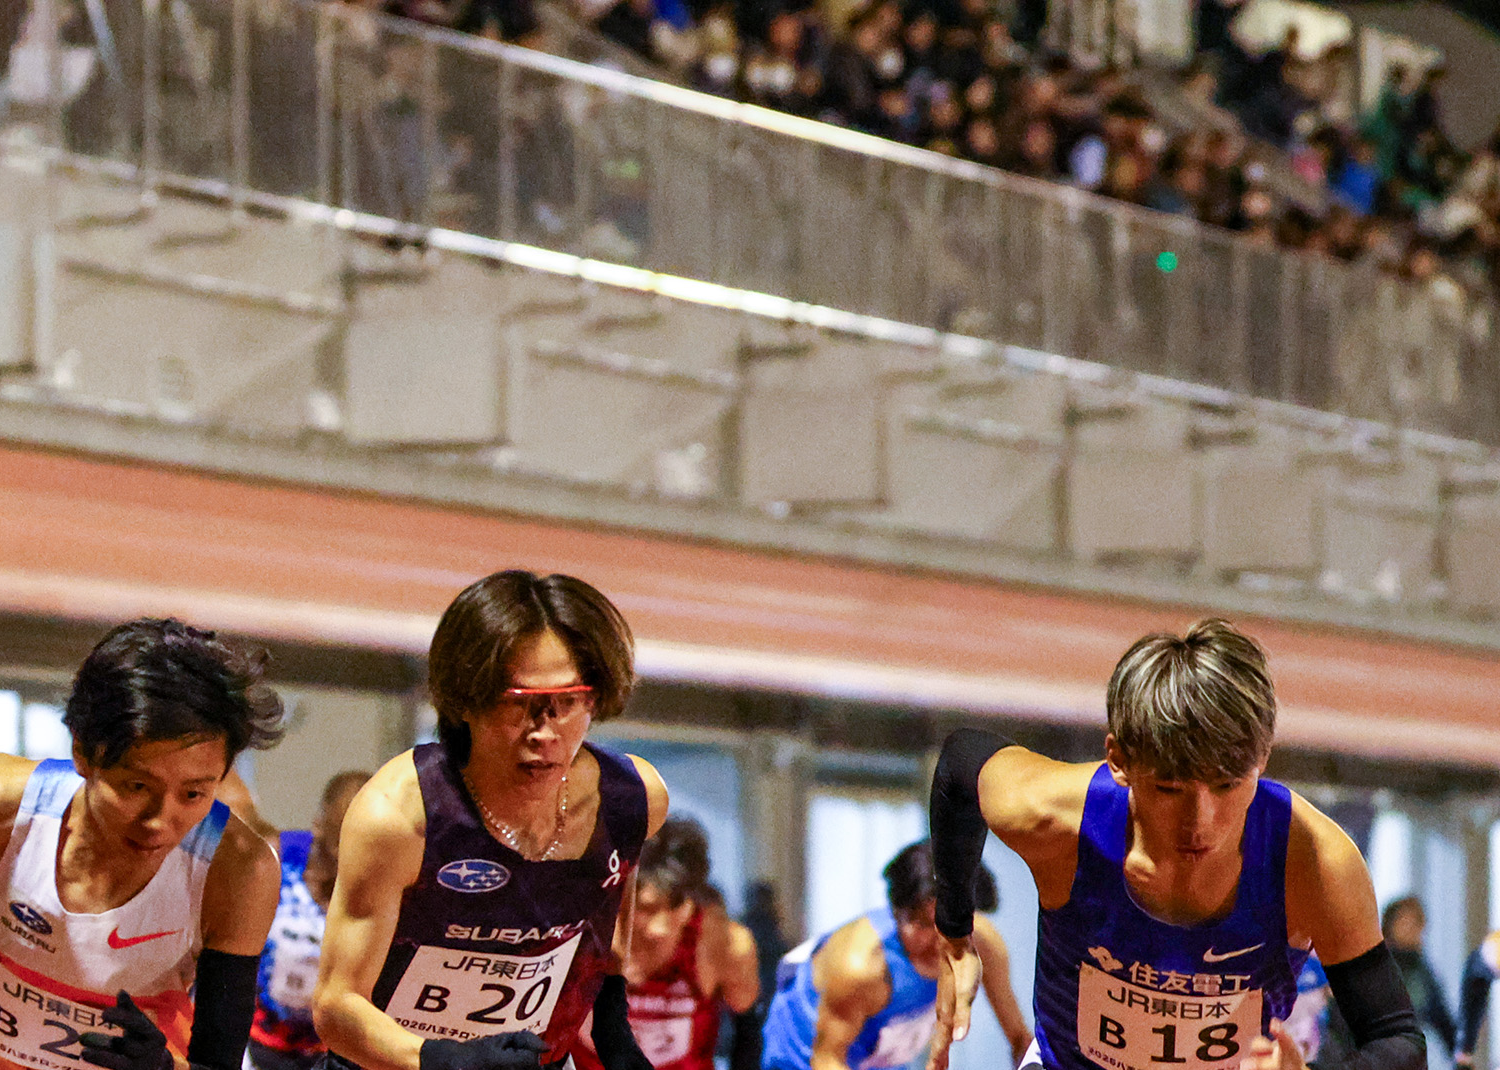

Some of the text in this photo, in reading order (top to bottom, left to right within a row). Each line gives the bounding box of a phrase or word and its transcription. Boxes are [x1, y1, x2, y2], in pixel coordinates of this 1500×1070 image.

[1, 915, 56, 954] SUBARU
[444, 953, 559, 980] JR東日本
[1127, 960, 1251, 995] 住友電工
[414, 976, 552, 1025] B 20
[1107, 986, 1232, 1020] JR東日本
[38, 1019, 85, 1060] 2
[1099, 1014, 1241, 1063] B 18
